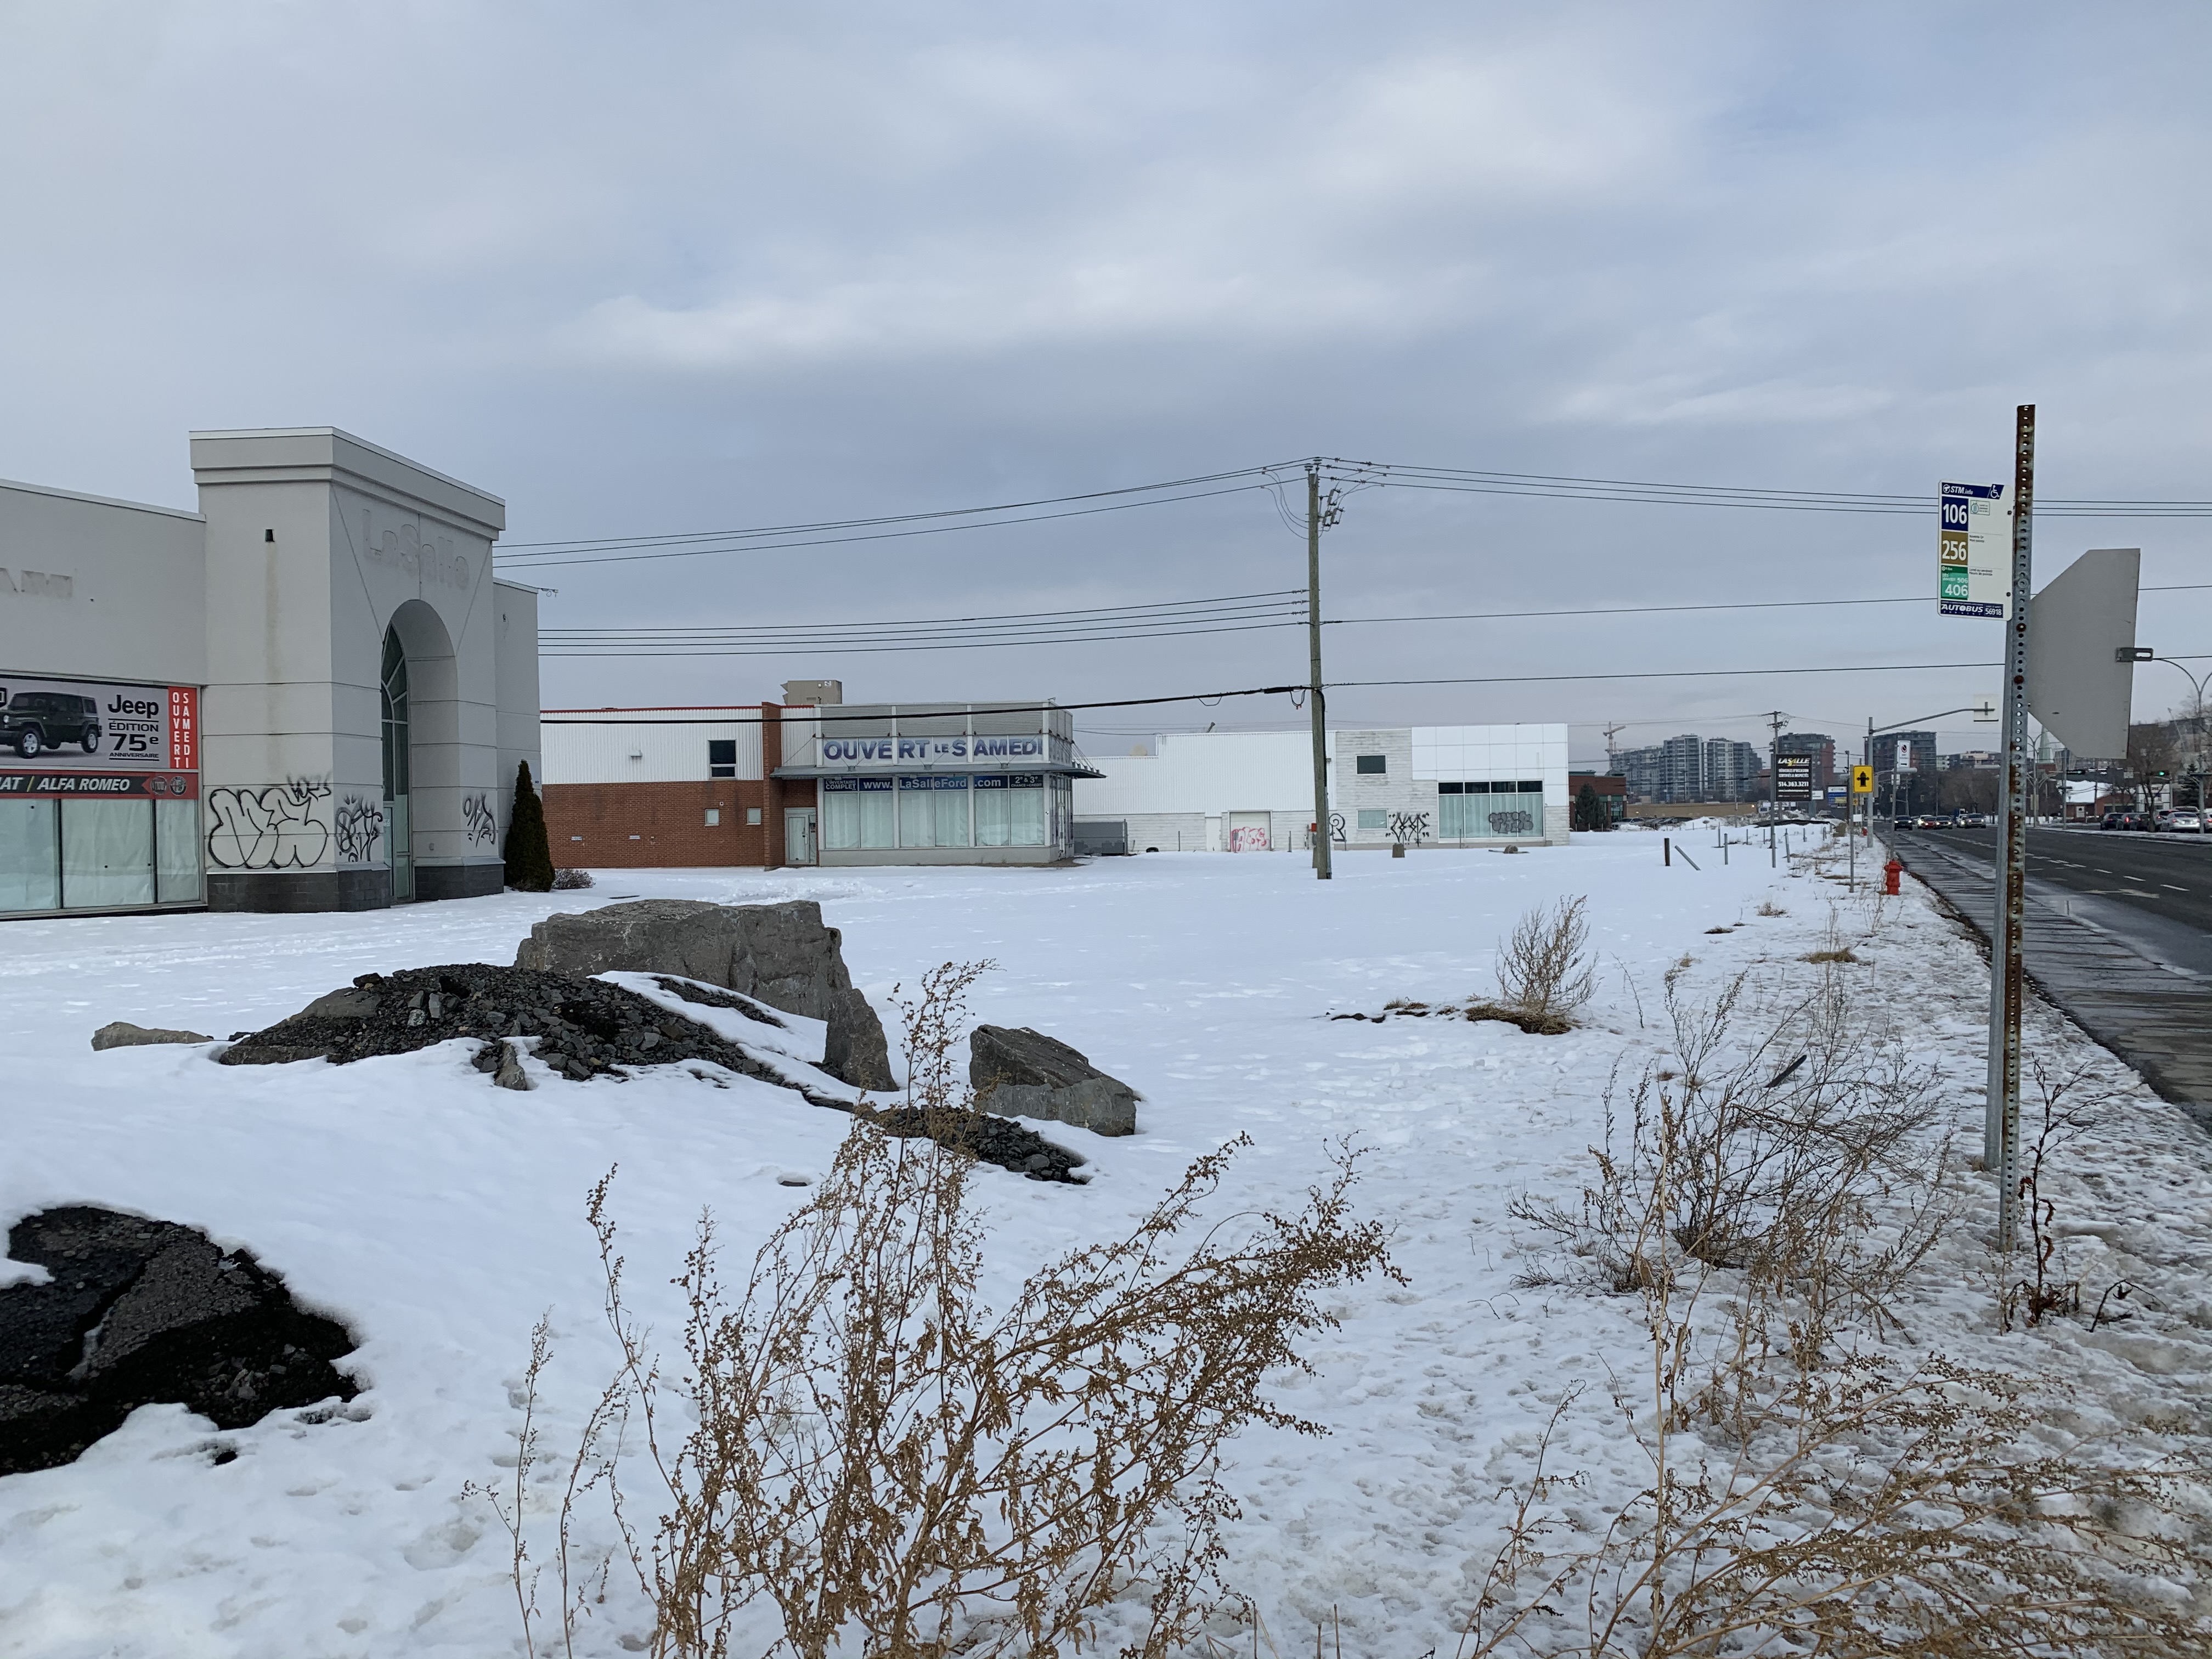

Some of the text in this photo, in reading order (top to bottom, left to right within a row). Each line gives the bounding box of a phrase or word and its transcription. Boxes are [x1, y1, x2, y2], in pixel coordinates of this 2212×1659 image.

[1943, 503, 1967, 524] 106
[1942, 540, 1967, 561] 256
[1945, 584, 1968, 596] 406
[1941, 603, 1984, 613] AUTOBUS
[108, 694, 159, 719] Jeep
[109, 720, 159, 732] ÉDITION
[172, 692, 180, 769] OUVERT
[182, 692, 190, 769] SAMEDI
[824, 739, 930, 760] OUVERT
[934, 743, 950, 753] LE
[952, 738, 1043, 757] SAMEDI
[0, 776, 24, 790] AT
[36, 777, 76, 791] ALFA
[78, 778, 131, 791] ROMEO
